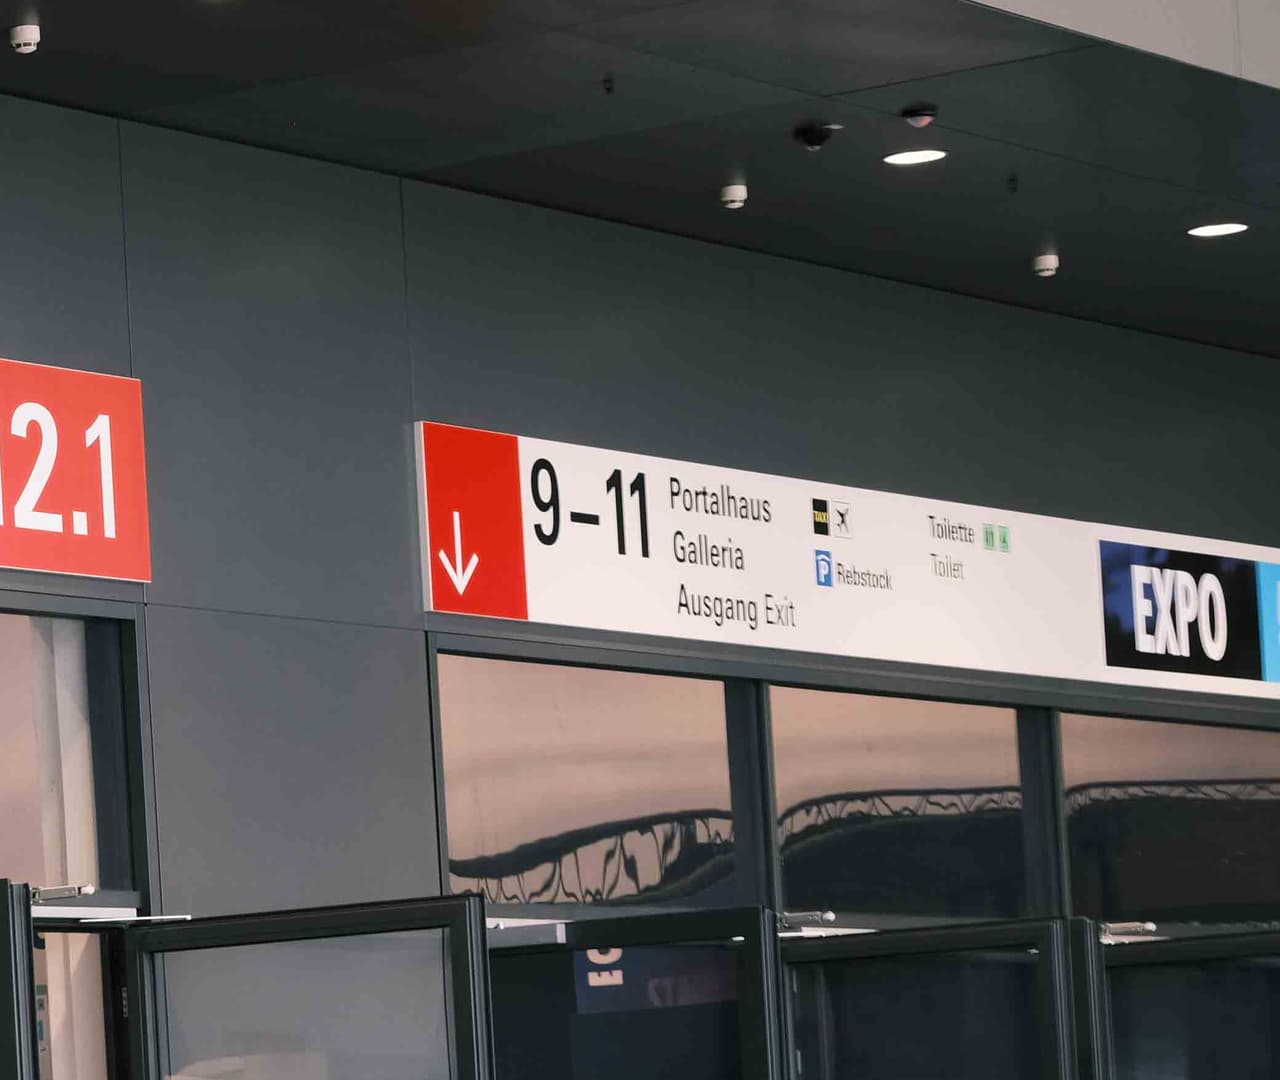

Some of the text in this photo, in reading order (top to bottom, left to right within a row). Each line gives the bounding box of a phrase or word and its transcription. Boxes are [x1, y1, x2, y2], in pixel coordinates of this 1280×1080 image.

[669, 476, 772, 522] Portalhaus
[673, 529, 745, 571] Galleria
[927, 514, 975, 544] Toilette
[837, 562, 894, 591] Rebstock
[930, 552, 965, 580] Toilet
[677, 583, 797, 631] Ausgang Exit
[1129, 564, 1228, 662] EXPO
